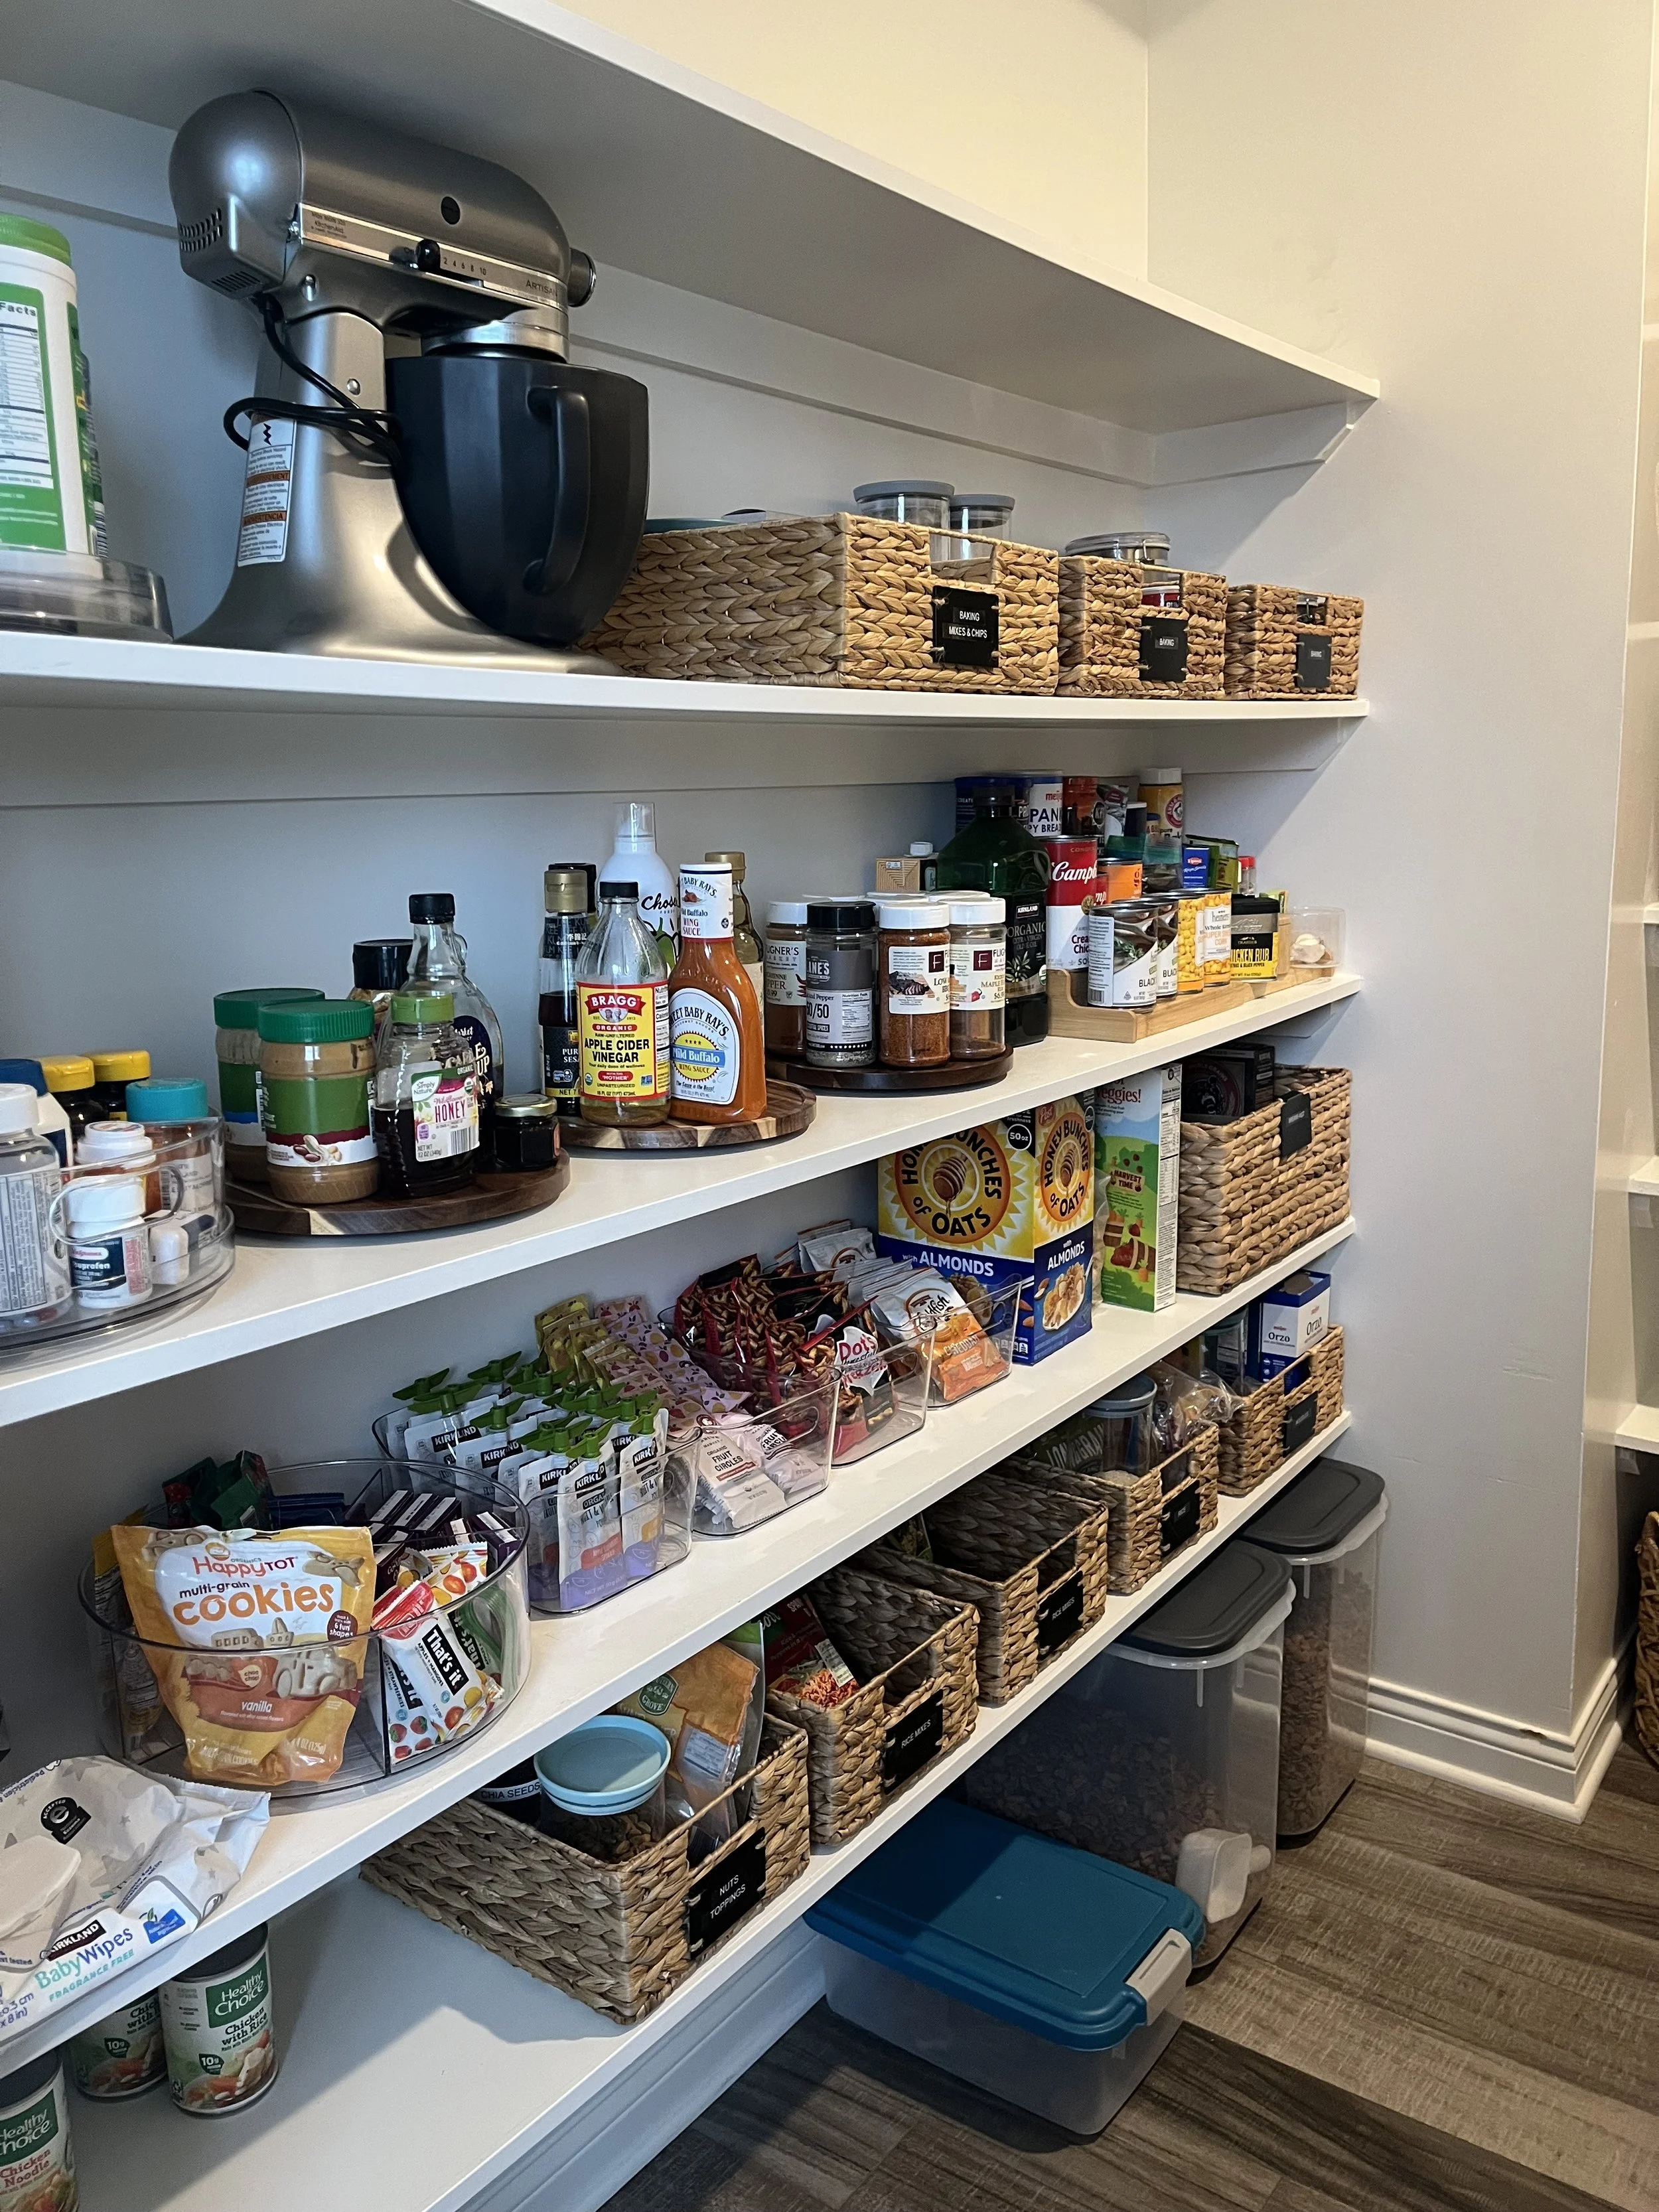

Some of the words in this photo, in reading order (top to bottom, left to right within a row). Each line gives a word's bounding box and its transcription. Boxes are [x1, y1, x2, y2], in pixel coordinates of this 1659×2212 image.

[0, 303, 36, 317] Facts
[960, 611, 979, 621] BAKING
[949, 626, 966, 636] MIXES
[972, 628, 987, 638] CHIPS
[1159, 638, 1174, 646] BAKING
[684, 877, 698, 886] BABY
[699, 880, 717, 897] RAY'S
[687, 908, 708, 917] Buffalo
[683, 927, 701, 936] SAUCE
[1256, 948, 1269, 962] RUB
[934, 978, 947, 986] LOW
[591, 995, 637, 1007] BRAGG
[685, 1007, 705, 1019] BABY
[705, 1013, 729, 1037] RAY'S
[585, 1038, 613, 1051] APPLE
[616, 1039, 650, 1051] CIDER
[592, 1051, 639, 1063] VINEGAR
[672, 1048, 687, 1060] Mild
[689, 1050, 720, 1064] Buffalo
[693, 1065, 710, 1074] SAUCE
[433, 1095, 464, 1104] Wildflower
[435, 1100, 466, 1123] HONEY
[1064, 1120, 1088, 1172] BUNCHES
[943, 1131, 1003, 1199] UNCHES
[1045, 1126, 1062, 1189] HONEY
[1114, 1169, 1142, 1183] HARVEST
[1118, 1179, 1133, 1190] TIME
[1059, 1181, 1085, 1217] OATS
[932, 1206, 991, 1236] OATS
[919, 1251, 994, 1277] ALMONDS
[1047, 1240, 1085, 1271] ALMONDS
[1307, 1317, 1322, 1335] Orzo
[1268, 1332, 1290, 1342] Orzo
[839, 1333, 876, 1361] Dot's
[707, 1445, 727, 1456] ORGANIC
[711, 1450, 733, 1463] FRUIT
[715, 1455, 743, 1472] CIRCLES
[179, 1581, 250, 1598] multi-grain
[173, 1582, 335, 1625] cookies
[1052, 1607, 1062, 1621] RICE
[417, 1643, 429, 1661] APPLES
[429, 1662, 444, 1687] MANGOES
[427, 1629, 455, 1672] That's
[449, 1668, 462, 1686] it
[388, 1670, 405, 1708] STRAWBERRIES
[242, 1699, 273, 1713] vanilla
[642, 1694, 664, 1711] GROVE
[901, 1733, 914, 1749] RICE
[914, 1719, 931, 1737] MIXES
[482, 1789, 504, 1800] CHIA
[508, 1781, 540, 1799] SEEDS
[43, 1799, 66, 1819] ACCEPTED
[719, 1875, 739, 1896] NUTS
[710, 1883, 746, 1919] TOPPINGS
[49, 1964, 109, 2002] FRAGRANCE
[111, 1949, 135, 1968] FREE
[222, 1970, 262, 2002] Healthy
[19, 1992, 34, 2004] cm
[215, 1979, 264, 2016] Choice
[127, 2013, 154, 2029] with
[222, 2029, 248, 2045] with
[250, 2013, 267, 2037] Rice
[225, 2007, 264, 2035] Chicken
[0, 2149, 50, 2178] Chicken
[5, 2160, 50, 2188] Noodle
